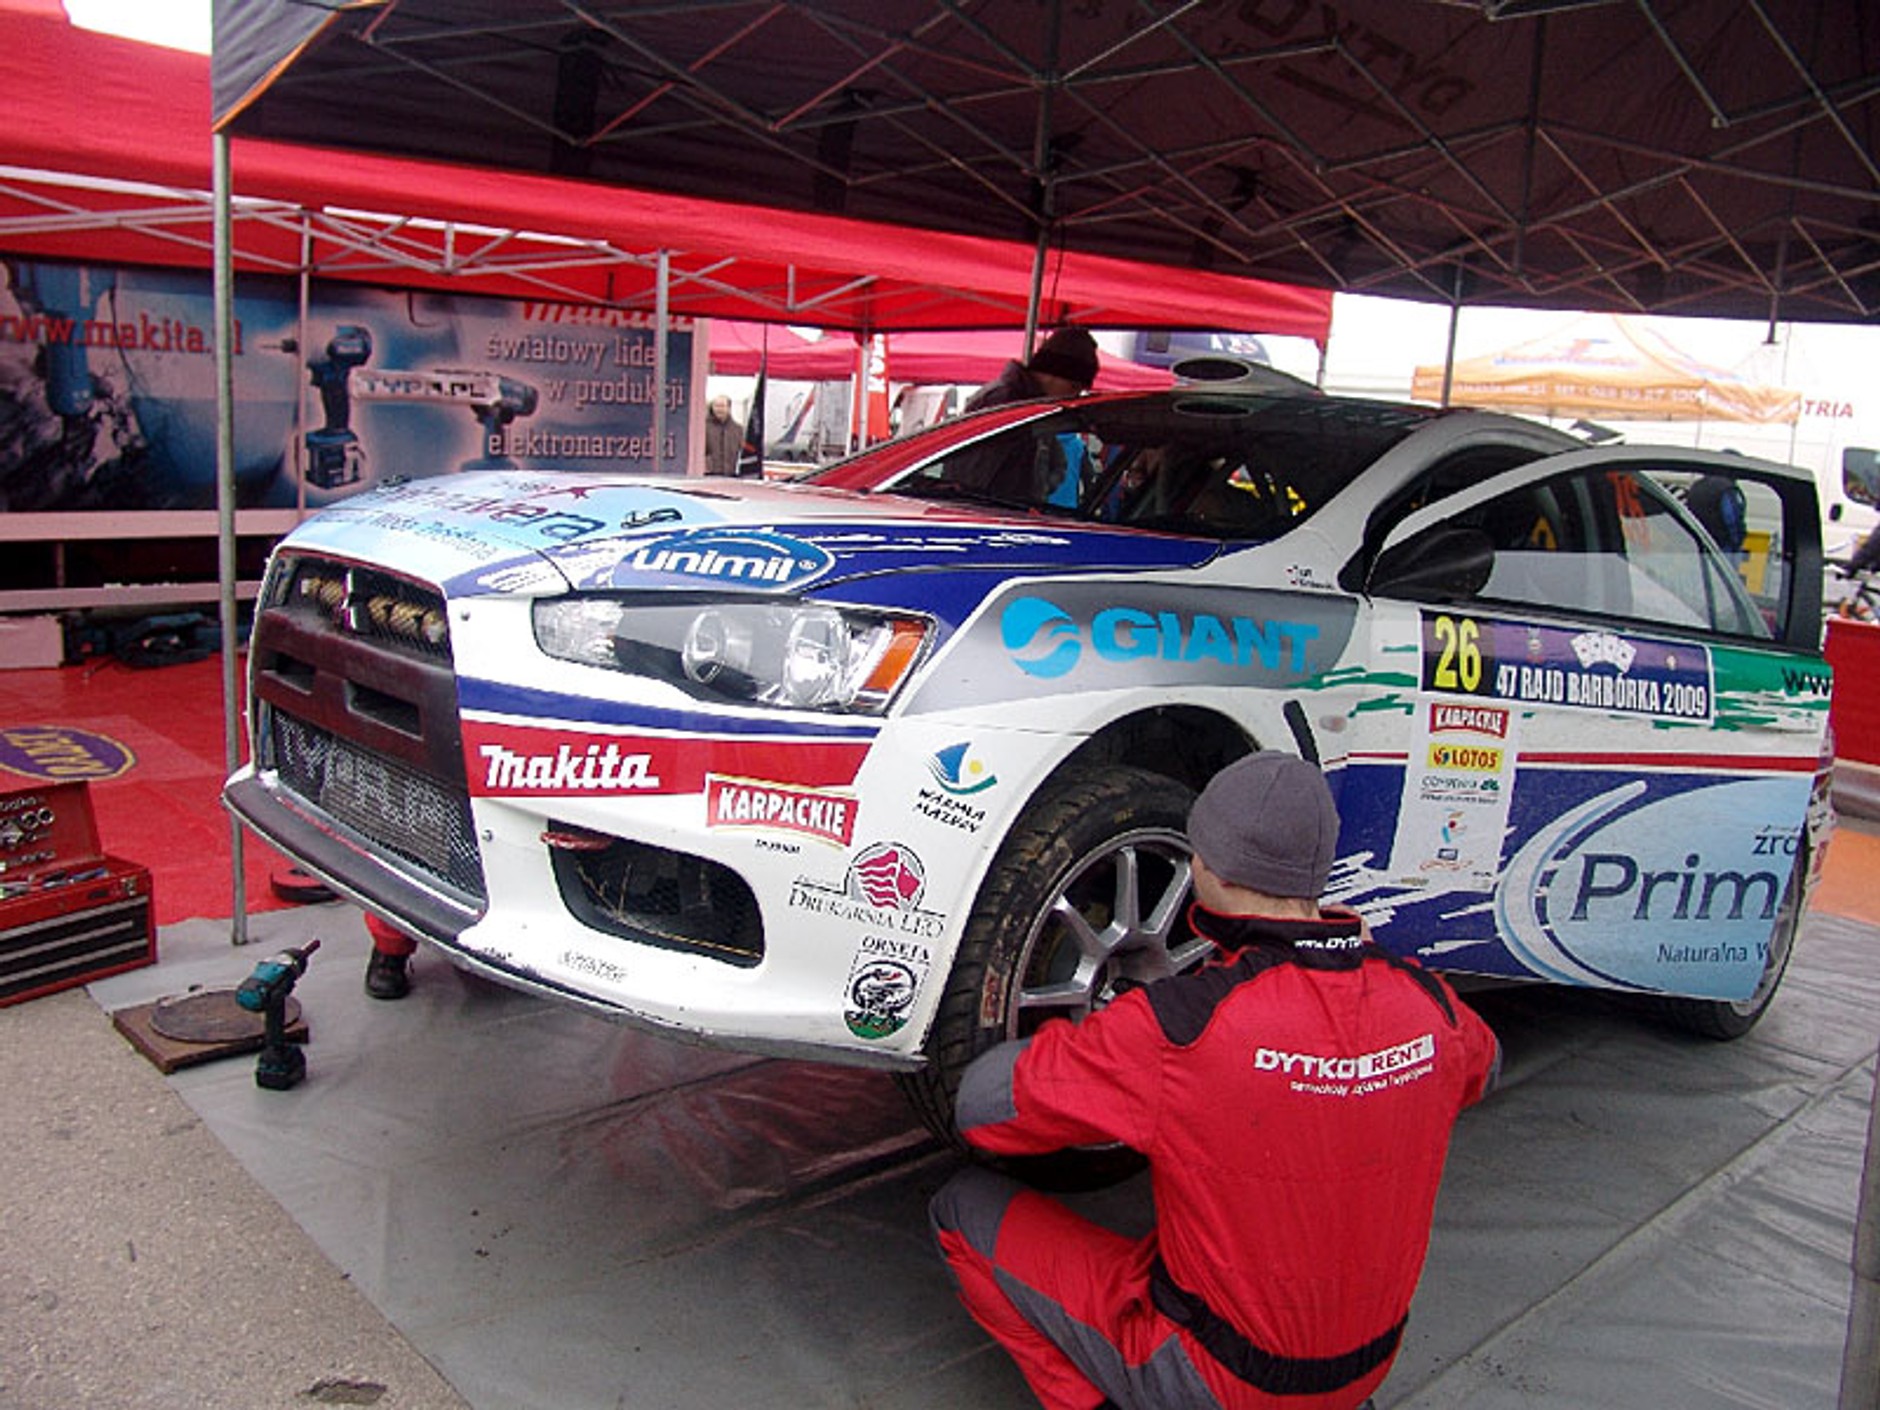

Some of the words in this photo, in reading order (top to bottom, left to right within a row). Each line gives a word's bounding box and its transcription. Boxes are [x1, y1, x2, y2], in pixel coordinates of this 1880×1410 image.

[0, 311, 244, 354] ww.makita.l
[487, 333, 605, 372] światowy
[614, 334, 658, 367] lide
[574, 373, 685, 411] produkji
[488, 428, 677, 462] elektronarzędi
[631, 549, 795, 582] unimil
[1091, 606, 1320, 673] GIANT
[1434, 615, 1483, 692] 26
[1496, 664, 1518, 697] 47
[1520, 667, 1564, 703] RAJD
[1663, 682, 1707, 716] 2009
[480, 744, 660, 789] makita
[1451, 749, 1498, 769] LOTOS
[717, 786, 846, 837] KARPACKIE
[1569, 853, 1777, 921] Prim
[861, 935, 930, 960] ORNETA
[1657, 943, 1747, 962] Naturalna
[1254, 1048, 1356, 1080] DYTKO
[1371, 1042, 1425, 1073] RENT
